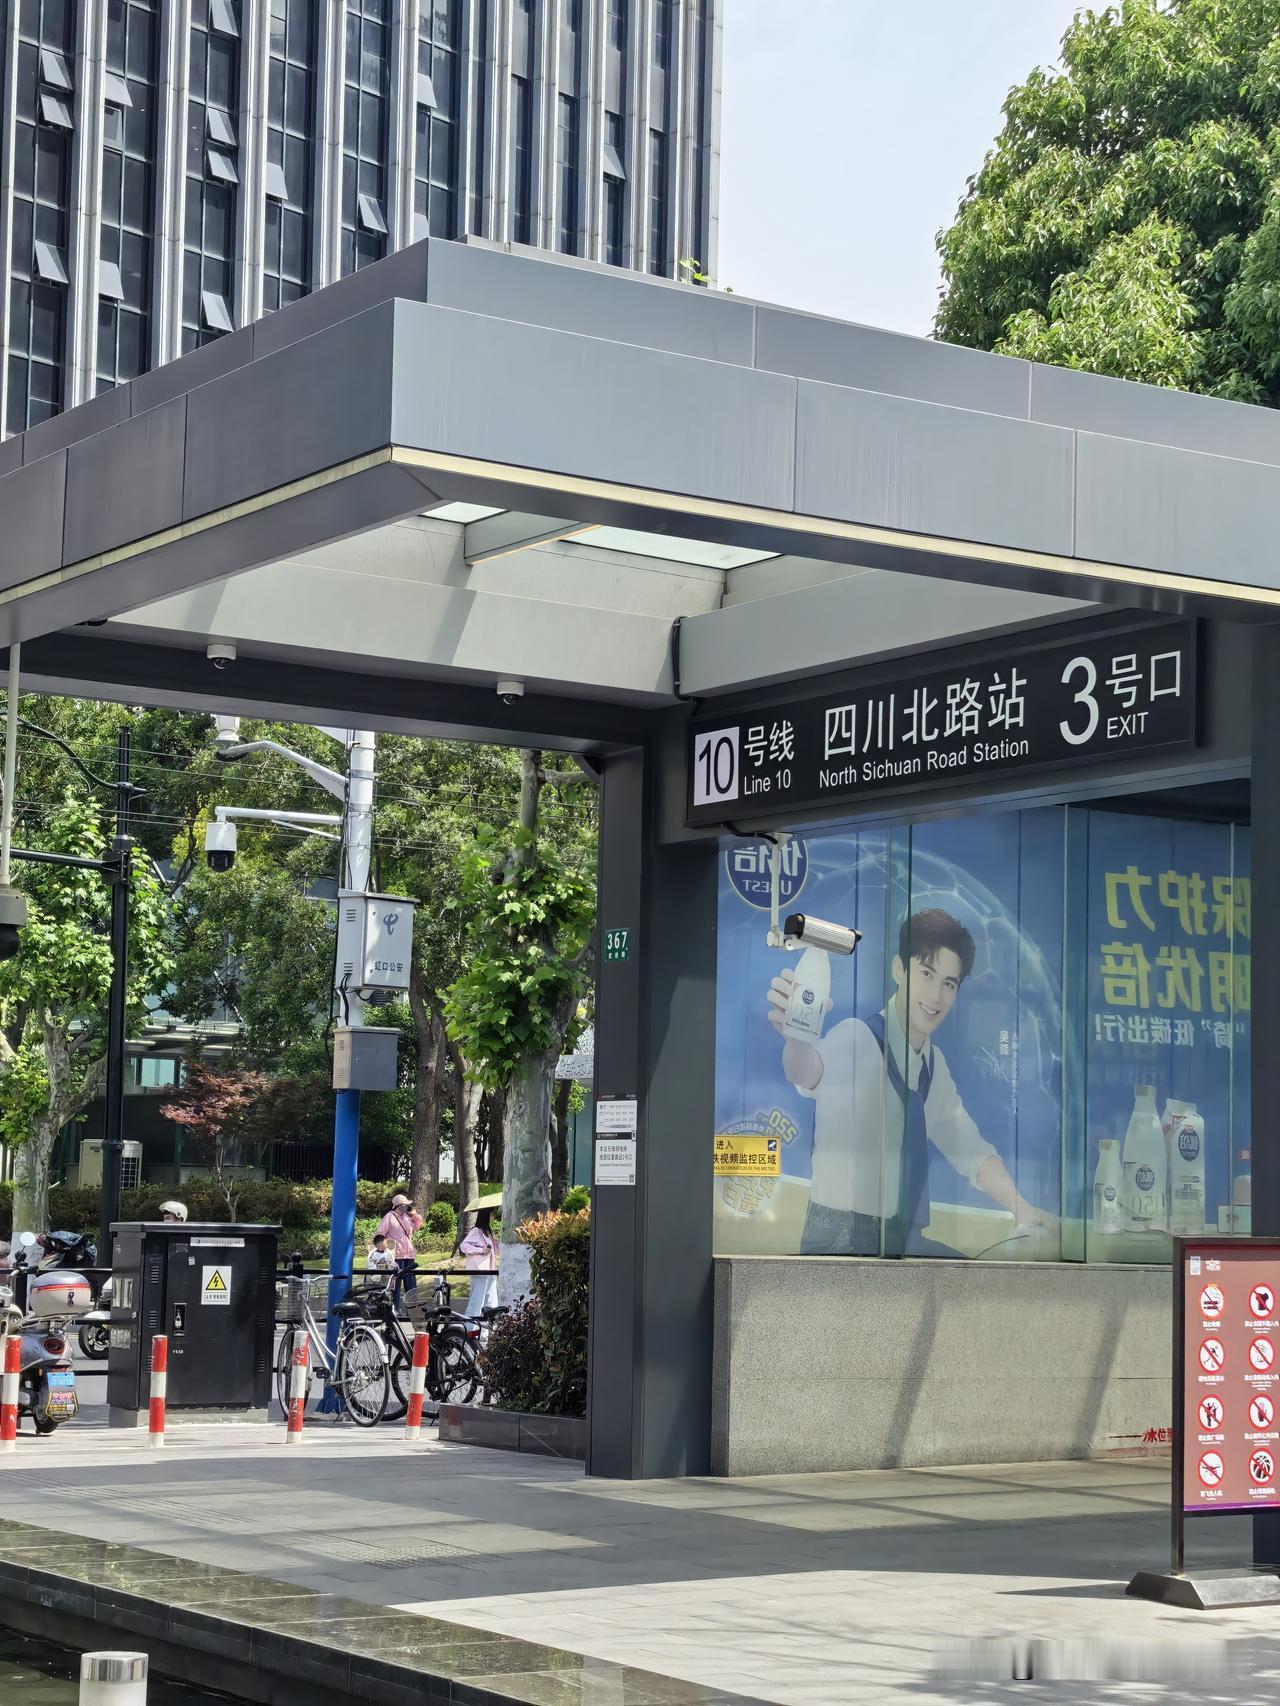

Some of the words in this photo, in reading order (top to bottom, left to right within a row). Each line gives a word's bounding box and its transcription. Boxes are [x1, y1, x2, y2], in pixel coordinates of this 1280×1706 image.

[1060, 656, 1099, 745] 3
[1105, 651, 1181, 709] 号口
[824, 667, 1027, 761] 四川北路站
[1106, 711, 1149, 739] EXIT
[699, 736, 735, 796] 10
[744, 719, 795, 767] 号线
[819, 765, 857, 788] North
[862, 758, 921, 781] Sichuan
[927, 746, 967, 770] Road
[973, 738, 1029, 763] Station
[744, 775, 771, 795] Line
[775, 769, 791, 790] 10
[607, 931, 628, 950] 367
[374, 961, 403, 973] 虹口公安
[716, 1140, 733, 1150] 进入
